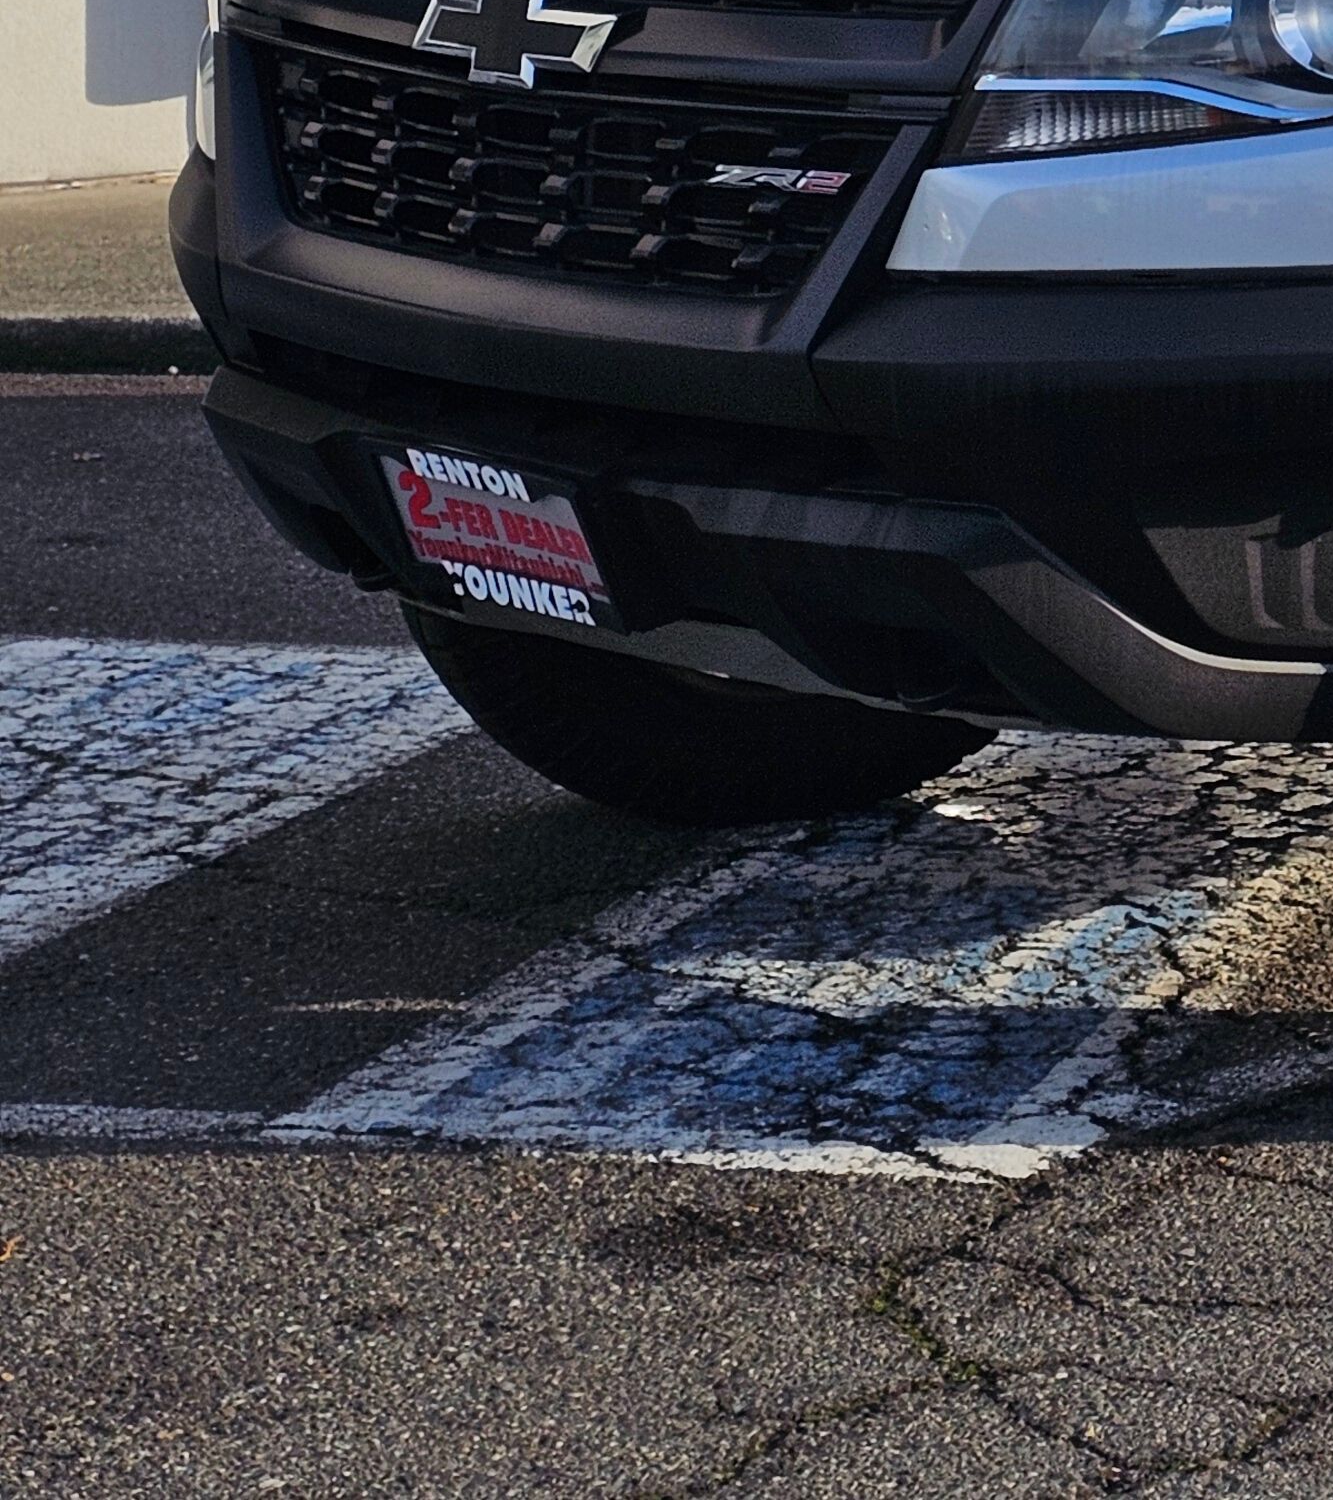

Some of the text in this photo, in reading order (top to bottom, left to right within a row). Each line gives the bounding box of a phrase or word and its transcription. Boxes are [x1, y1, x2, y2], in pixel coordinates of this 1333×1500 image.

[706, 163, 851, 195] ZR2
[406, 448, 530, 503] RENTON
[499, 509, 594, 565] DEALER
[440, 560, 597, 627] YOUNKER
